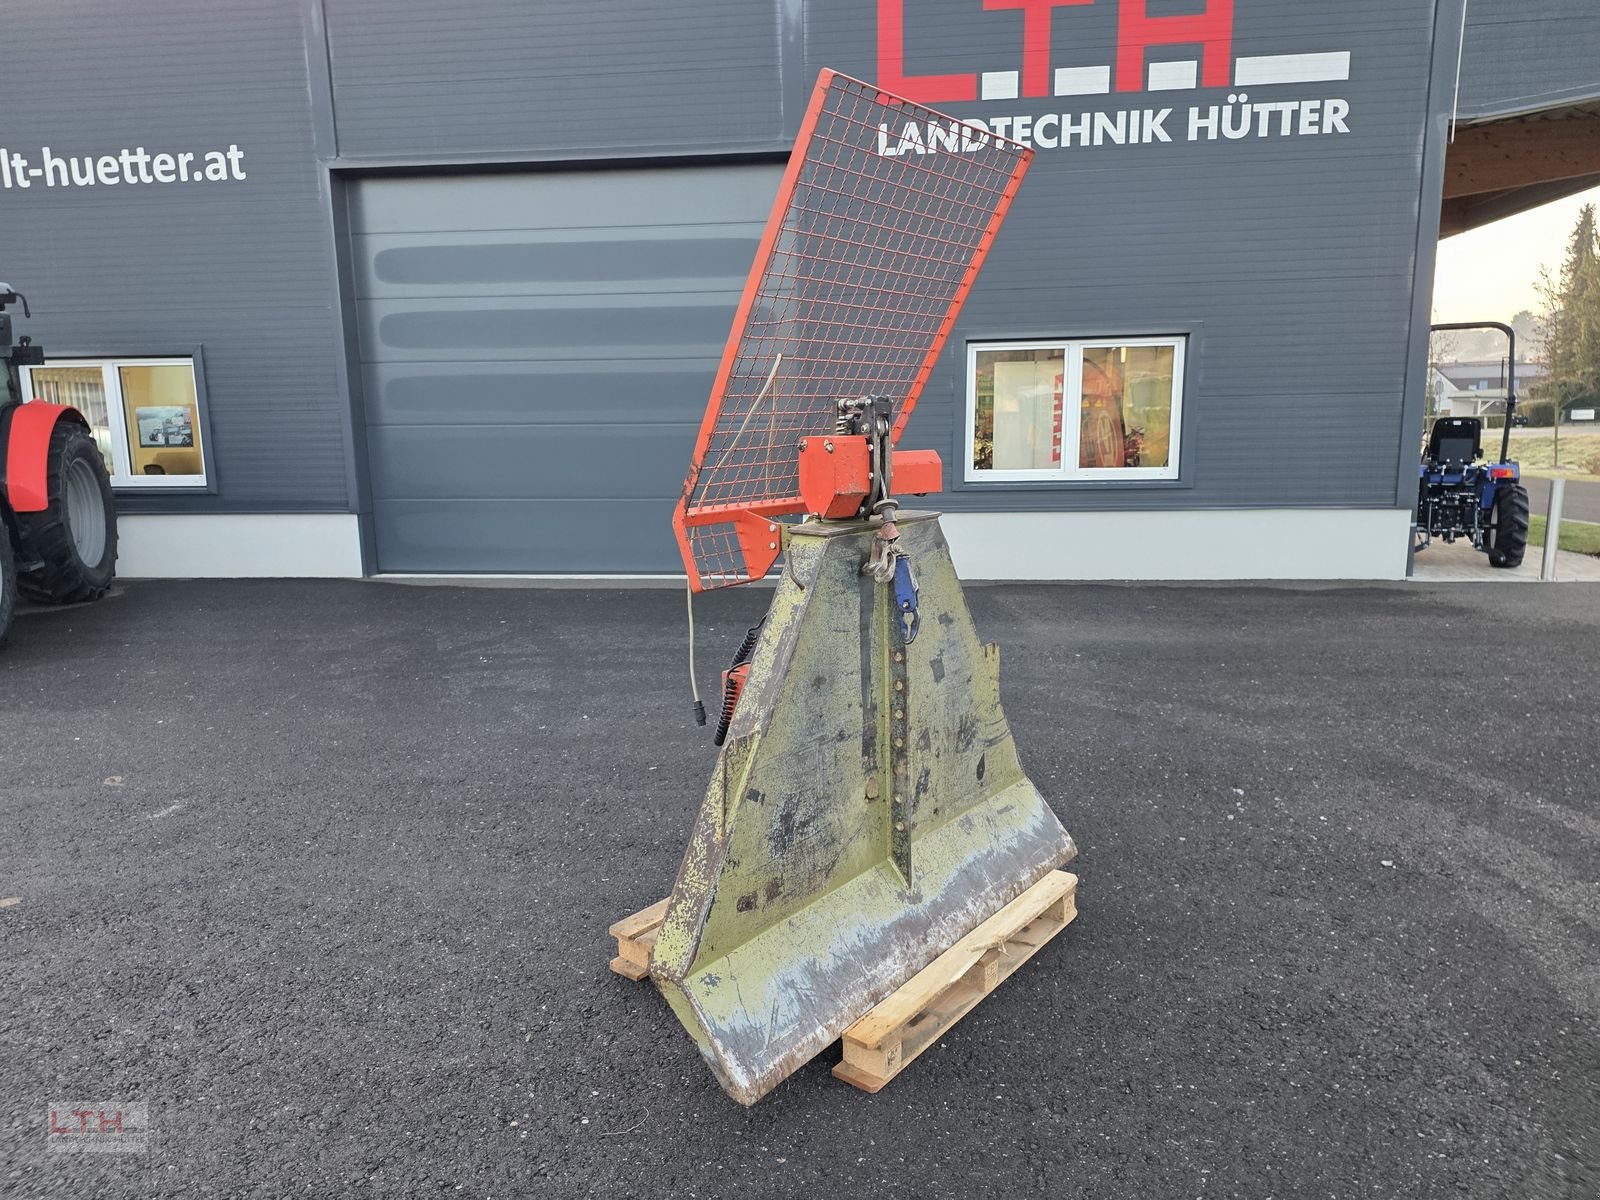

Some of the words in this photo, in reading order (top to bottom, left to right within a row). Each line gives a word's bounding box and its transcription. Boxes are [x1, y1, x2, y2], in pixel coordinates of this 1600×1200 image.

[877, 0, 1235, 104] LTH
[877, 107, 1173, 157] LANDTECHNIK
[1187, 93, 1351, 141] HÜTTER
[0, 144, 247, 188] lt-huetter.at
